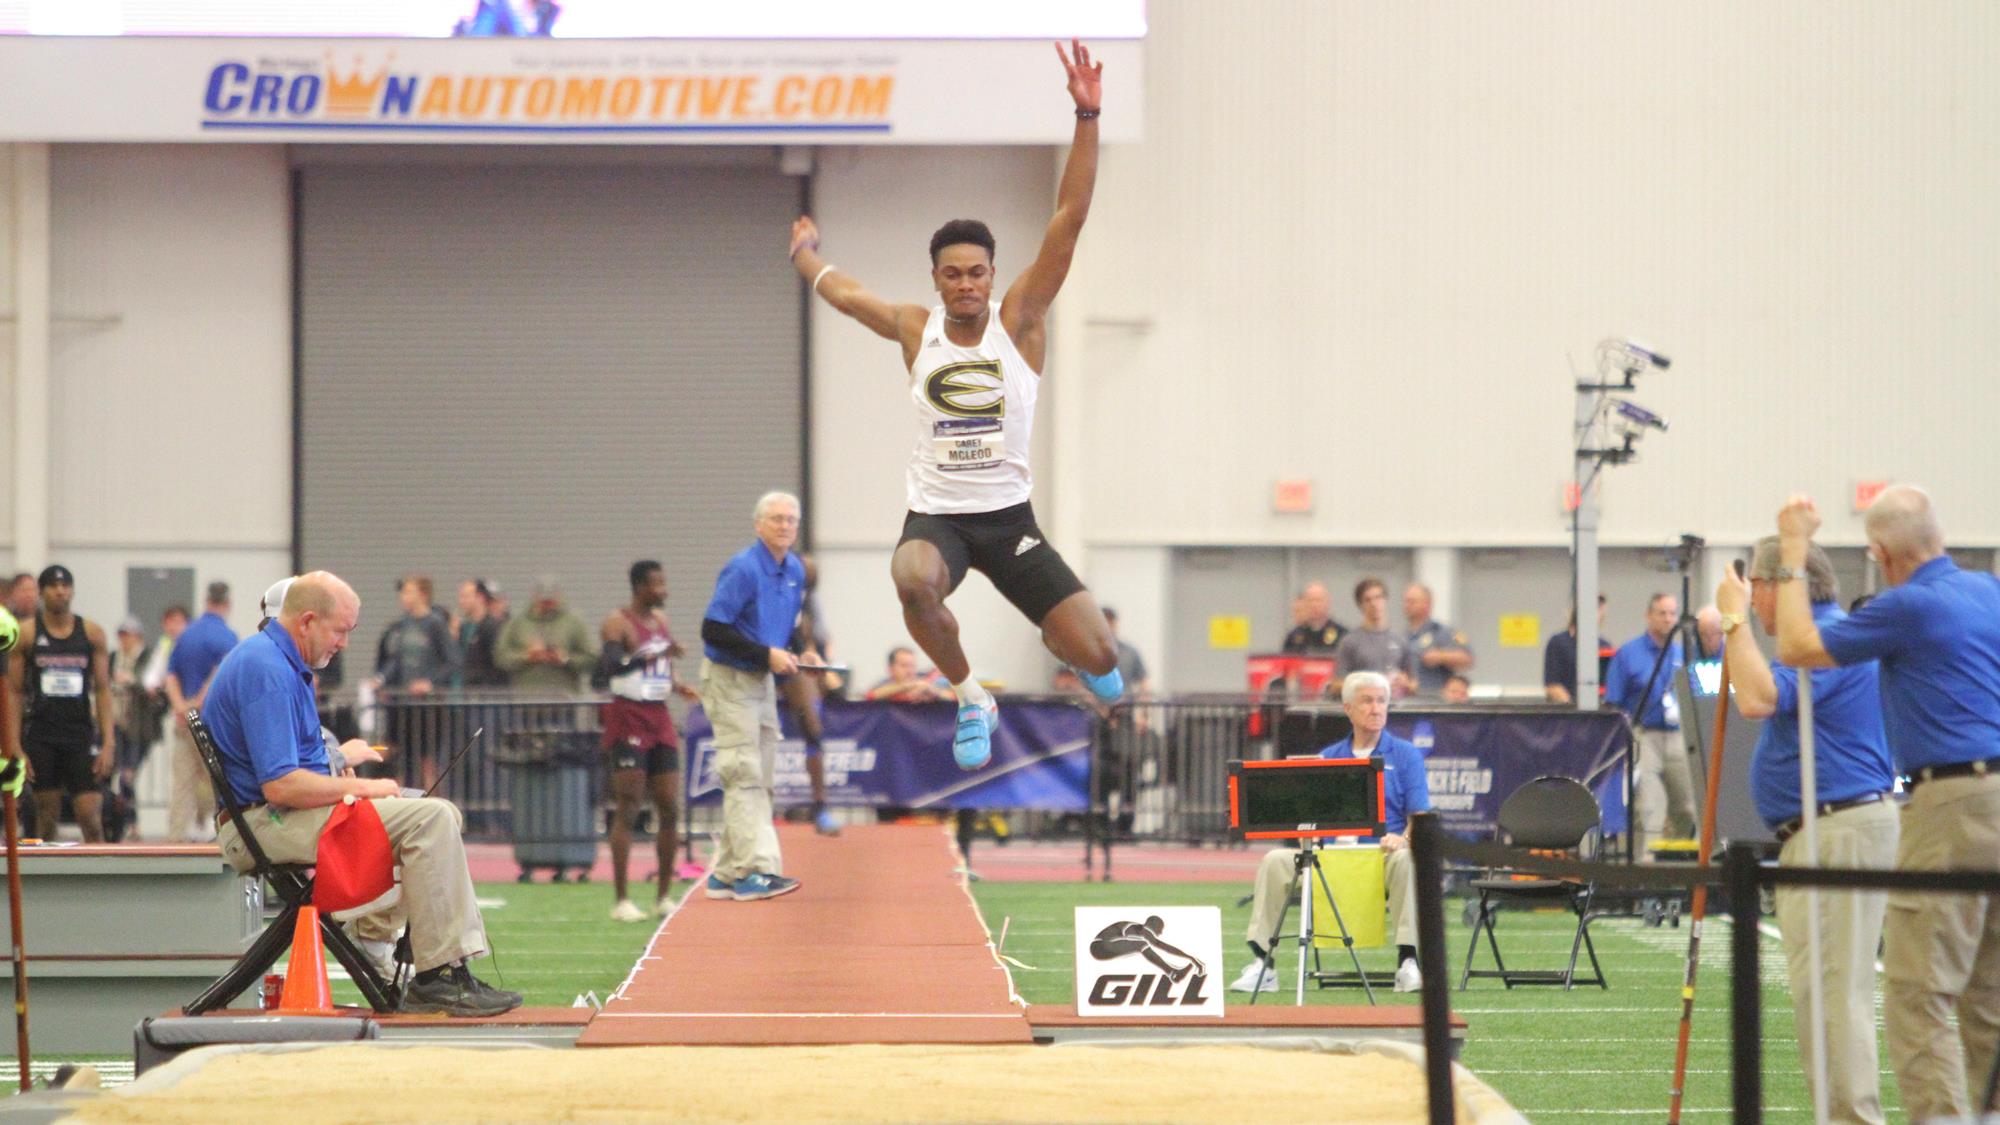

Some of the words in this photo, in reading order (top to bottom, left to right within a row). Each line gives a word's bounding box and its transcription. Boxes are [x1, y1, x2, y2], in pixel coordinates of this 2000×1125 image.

[948, 447, 992, 462] MCLEOD
[1297, 822, 1317, 831] GILL
[1088, 974, 1209, 1006] GILL
